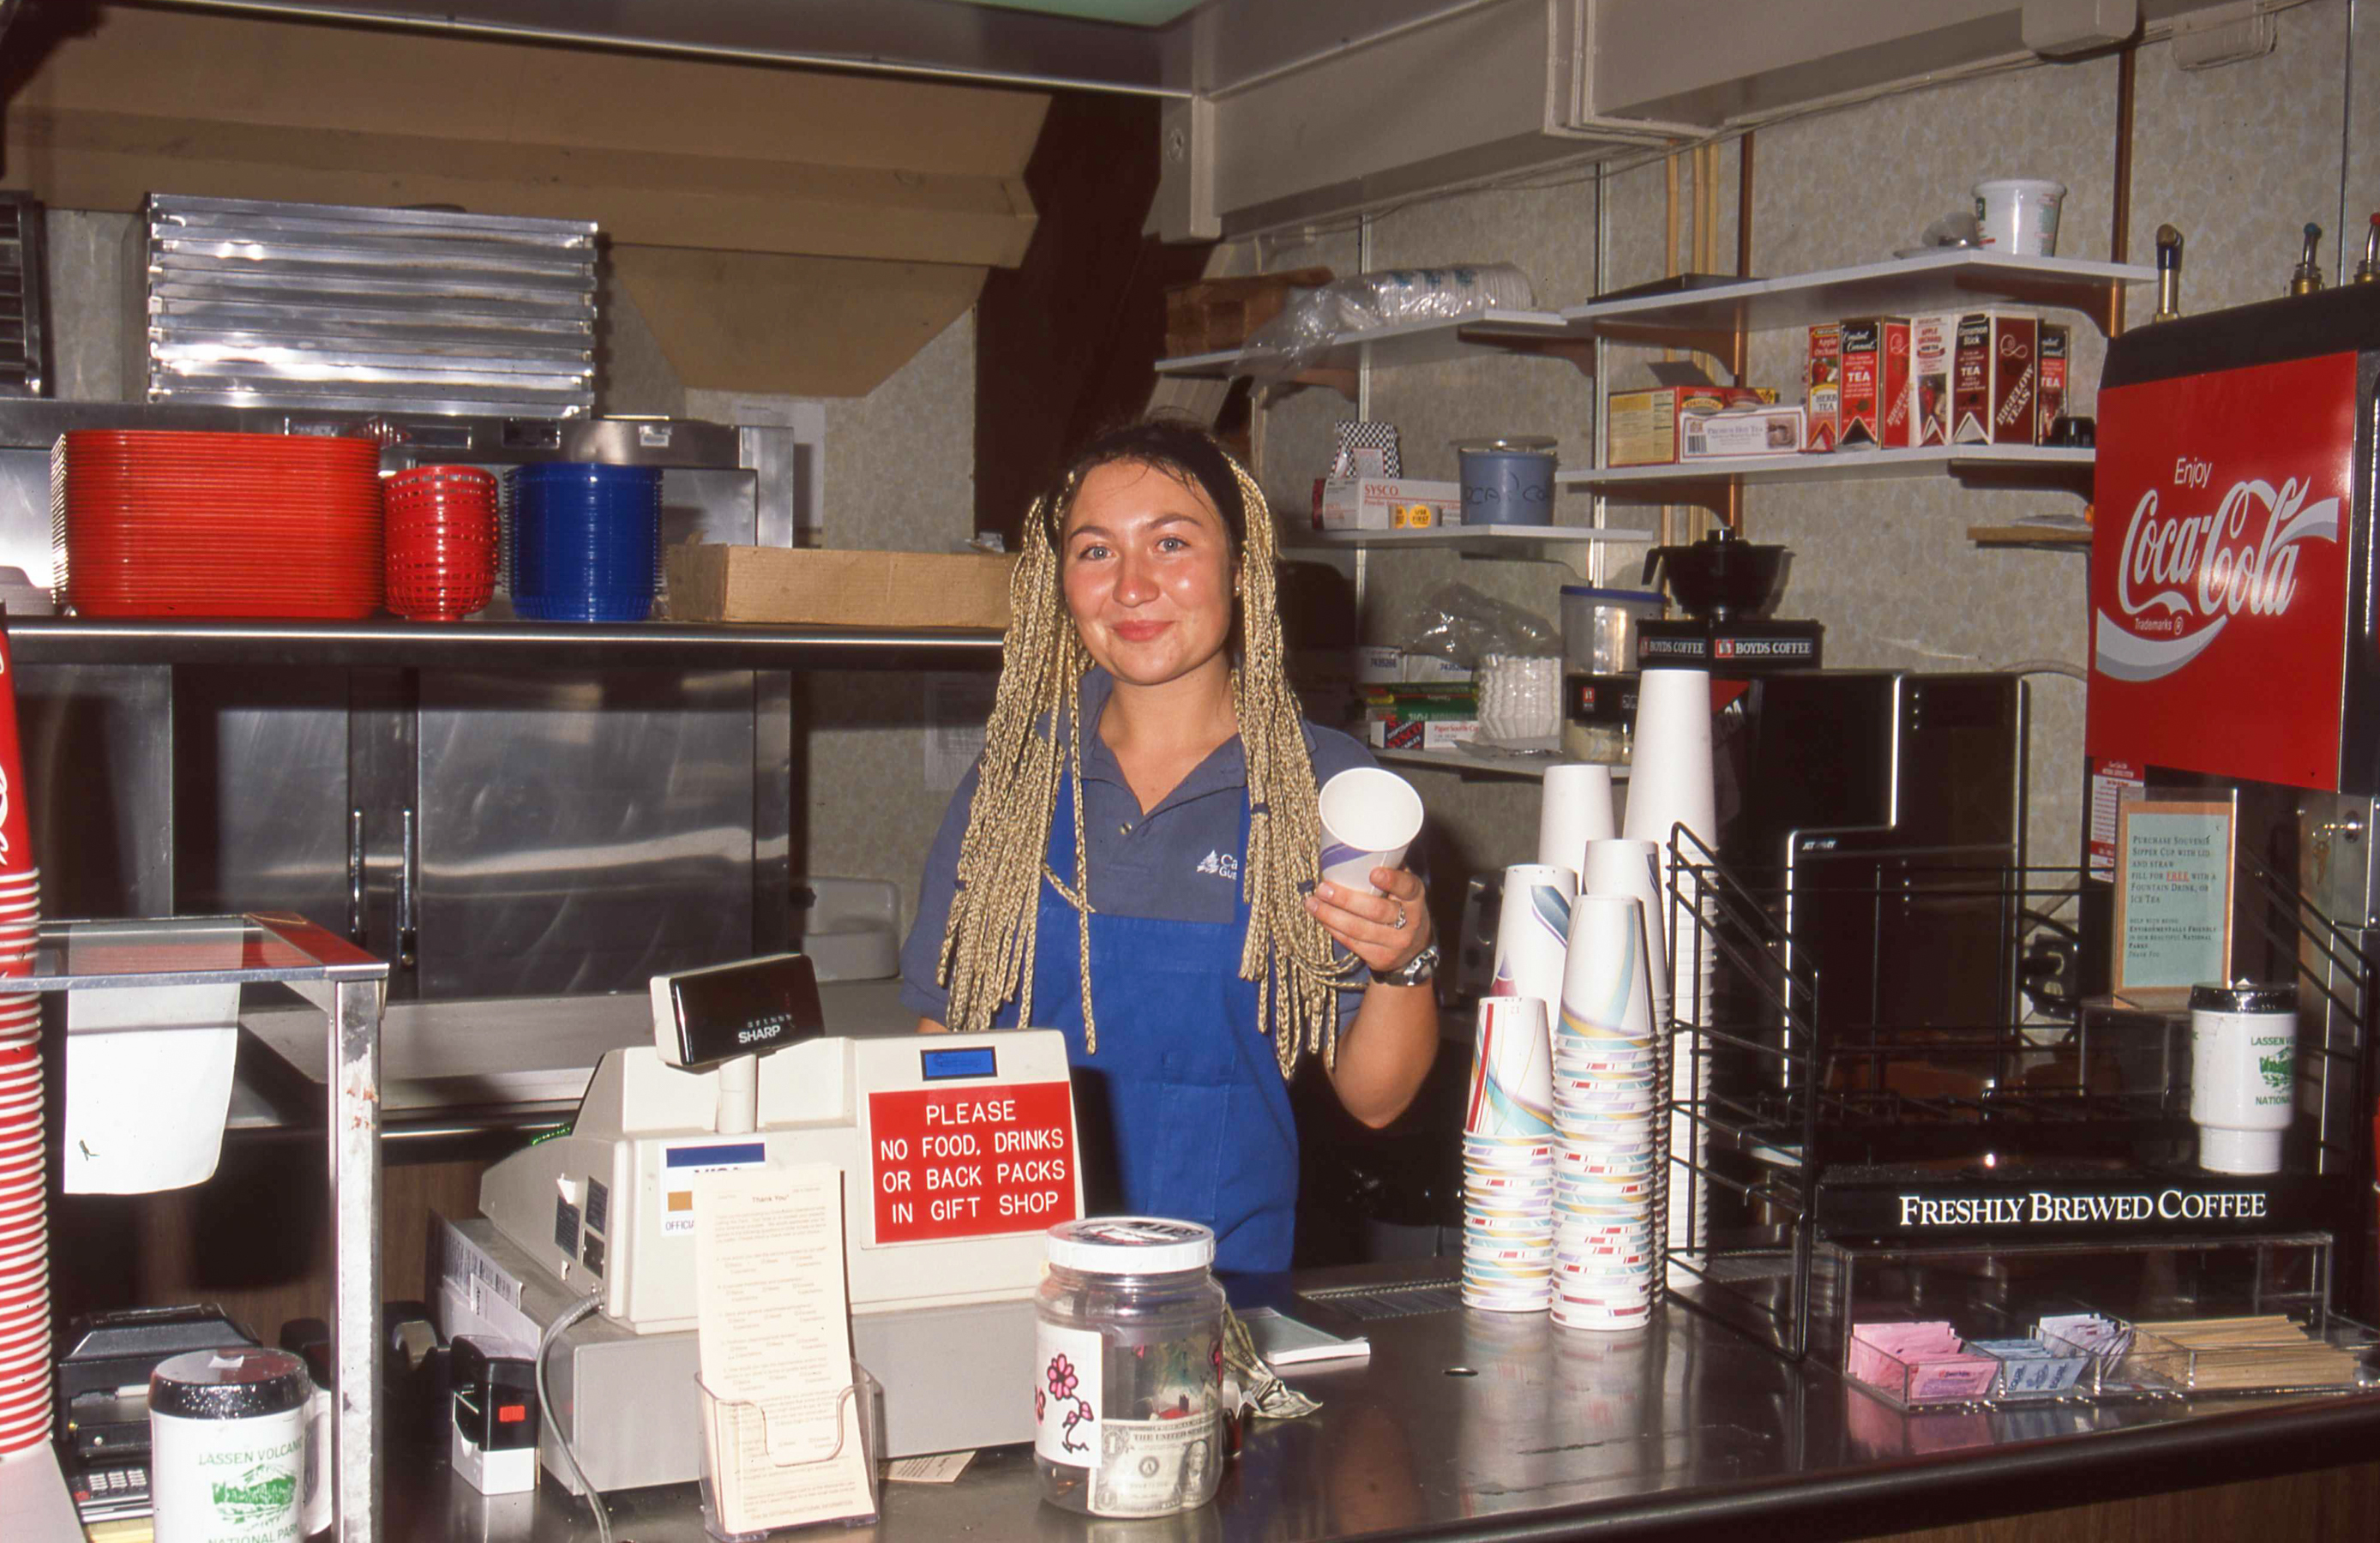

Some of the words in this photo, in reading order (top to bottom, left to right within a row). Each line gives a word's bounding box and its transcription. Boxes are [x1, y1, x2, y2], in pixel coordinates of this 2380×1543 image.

[1848, 371, 1871, 382] TEA
[1961, 366, 1980, 377] TEA
[2041, 376, 2060, 387] TEA
[1996, 363, 2034, 426] BIGELOW
[1818, 402, 1834, 411] TEA
[2005, 388, 2031, 426] TEAS
[2174, 457, 2212, 489] Enjoy
[1365, 483, 1398, 496] SYSCO
[2118, 476, 2311, 616] Coca-Cola
[2135, 617, 2172, 631] Trademarks
[1650, 641, 1672, 652] BOYDS
[1673, 642, 1704, 654] COFFEE
[1735, 642, 1771, 654] BOYDS
[1772, 642, 1812, 654] COFFEE
[2133, 835, 2170, 844] PURCHASE
[2173, 836, 2209, 845] SOUVENIR
[2133, 847, 2157, 856] SIPPER
[2160, 847, 2175, 856] CUP
[2166, 872, 2189, 882] FREE
[2131, 883, 2168, 892] FOUNTAIN
[738, 1025, 780, 1043] SHARP
[2251, 1036, 2285, 1046] LASSEN
[926, 1100, 1016, 1126] PLEASE
[880, 1139, 908, 1161] NO
[995, 1128, 1064, 1153] DRINKS
[882, 1170, 911, 1192] OR
[926, 1166, 982, 1190] BACK
[997, 1160, 1065, 1184] PACKS
[892, 1203, 913, 1223] IN
[931, 1198, 981, 1221] GIFT
[999, 1192, 1059, 1216] SHOP
[1899, 1196, 2026, 1226] FRESHLY
[2028, 1192, 2155, 1222] BREWED
[2158, 1189, 2268, 1219] COFFEE
[1156, 1431, 1186, 1441] UNITED
[198, 1451, 254, 1465] LASSEN
